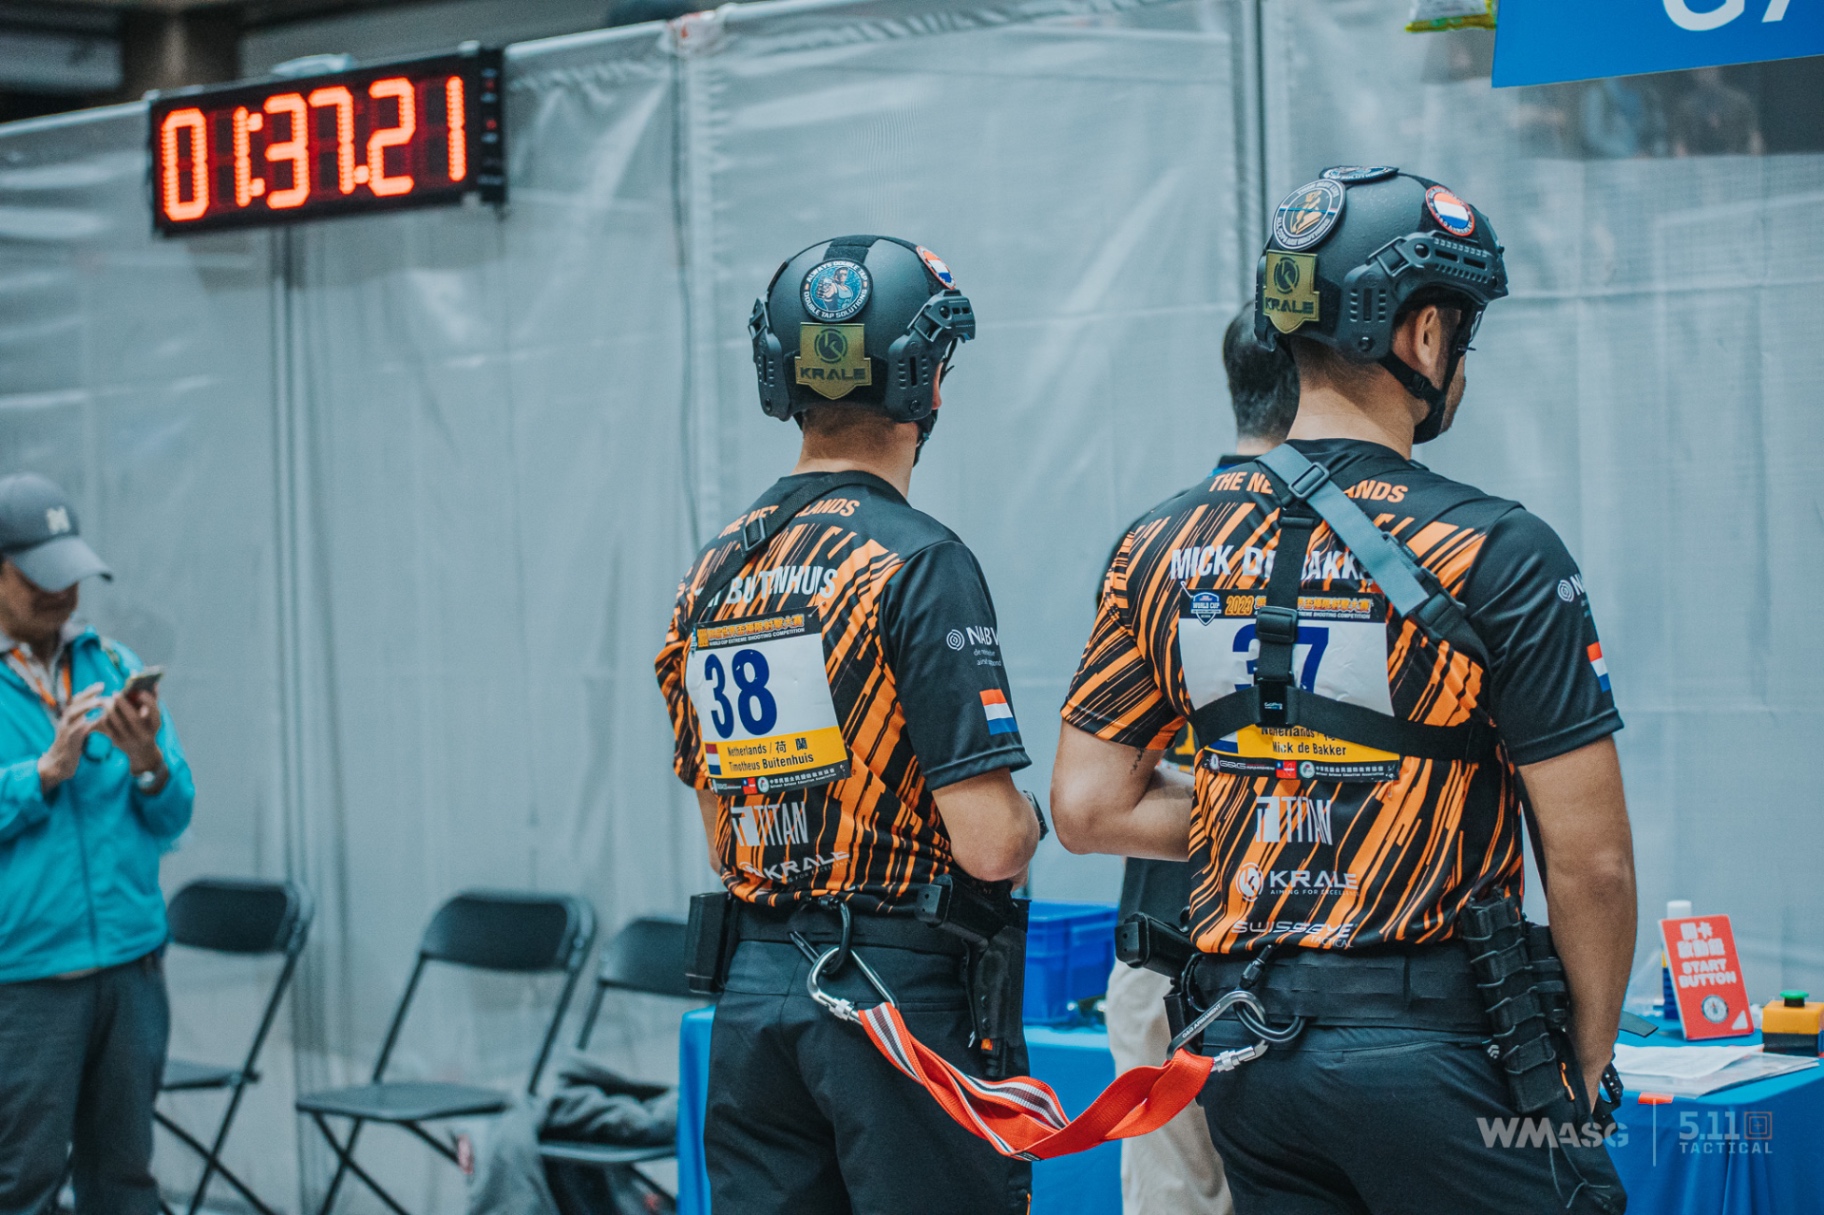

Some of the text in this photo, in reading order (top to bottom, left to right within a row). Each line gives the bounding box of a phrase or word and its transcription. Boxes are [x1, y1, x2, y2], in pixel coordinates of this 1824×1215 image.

[803, 289, 868, 319] DOUBLE TAP SOLUTIONS
[1266, 297, 1314, 315] KRALE
[800, 366, 866, 381] KRALE
[1208, 471, 1248, 492] THE
[1170, 544, 1234, 580] MICK
[1224, 595, 1255, 616] 2023
[772, 627, 805, 637] COMPETITION
[704, 648, 778, 739] 38
[727, 743, 767, 757] Netherlands
[1272, 742, 1346, 756] Mick de Bakker
[728, 753, 814, 772] Timotheus Buitenhuis
[754, 801, 809, 846] TITAN
[763, 851, 850, 881] KRALE
[1269, 869, 1359, 890] KRALE
[1310, 935, 1354, 948] TACTICAL
[1681, 958, 1727, 975] START
[1678, 971, 1737, 989] BUTTON
